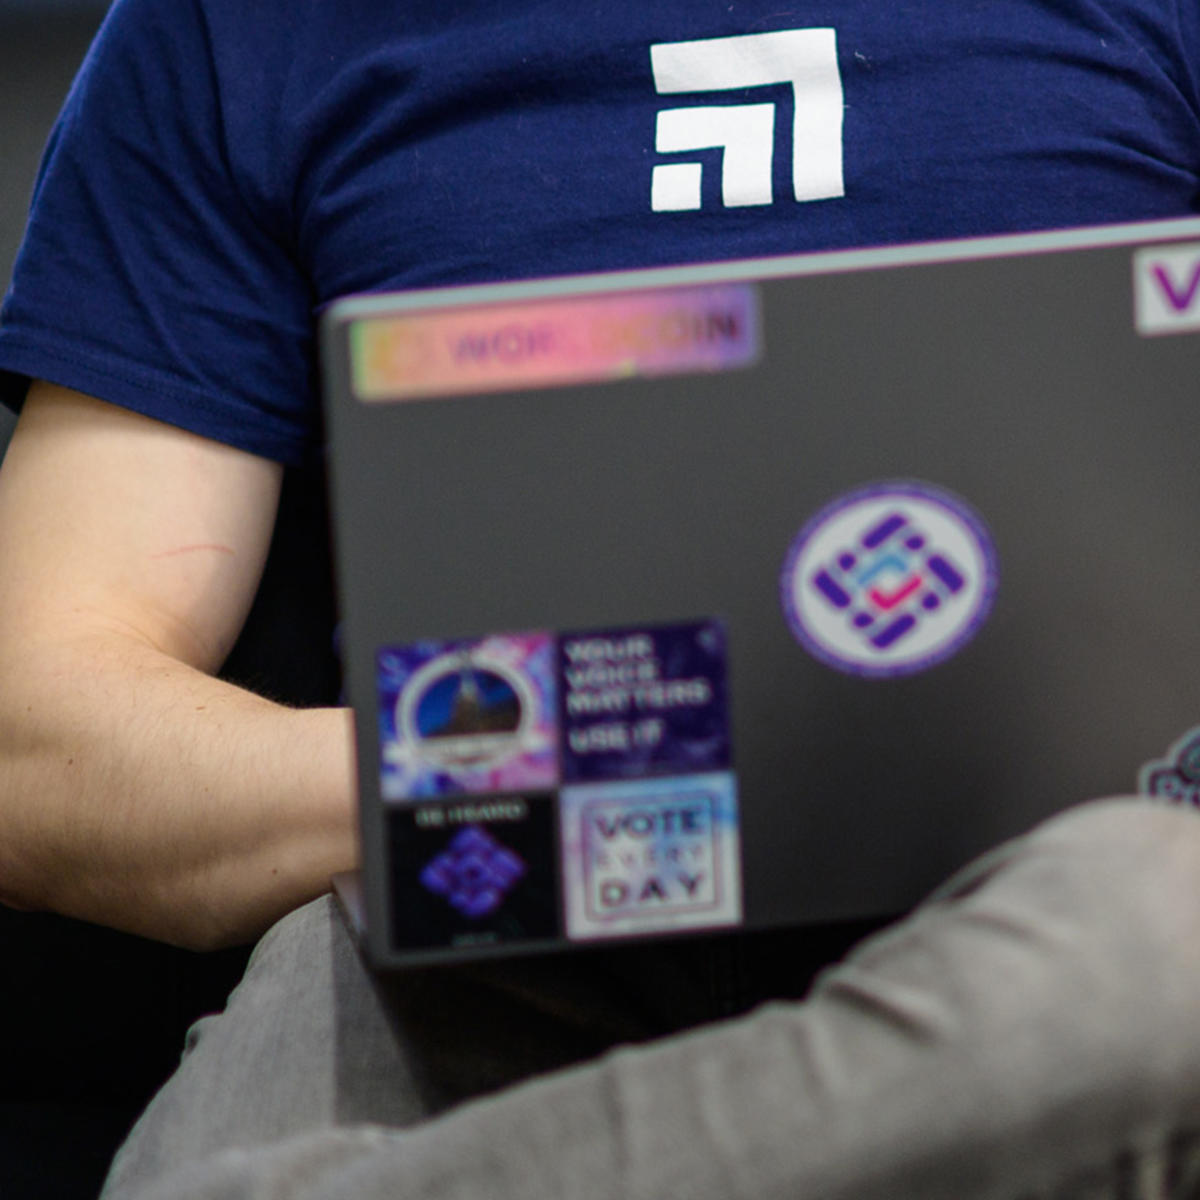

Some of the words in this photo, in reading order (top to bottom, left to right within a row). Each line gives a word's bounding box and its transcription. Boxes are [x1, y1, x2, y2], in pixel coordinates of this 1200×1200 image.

[564, 634, 654, 663] YOUR
[566, 677, 713, 716] MATTERS
[568, 721, 631, 753] USE
[594, 806, 703, 841] VOTE
[599, 872, 705, 908] DAY
